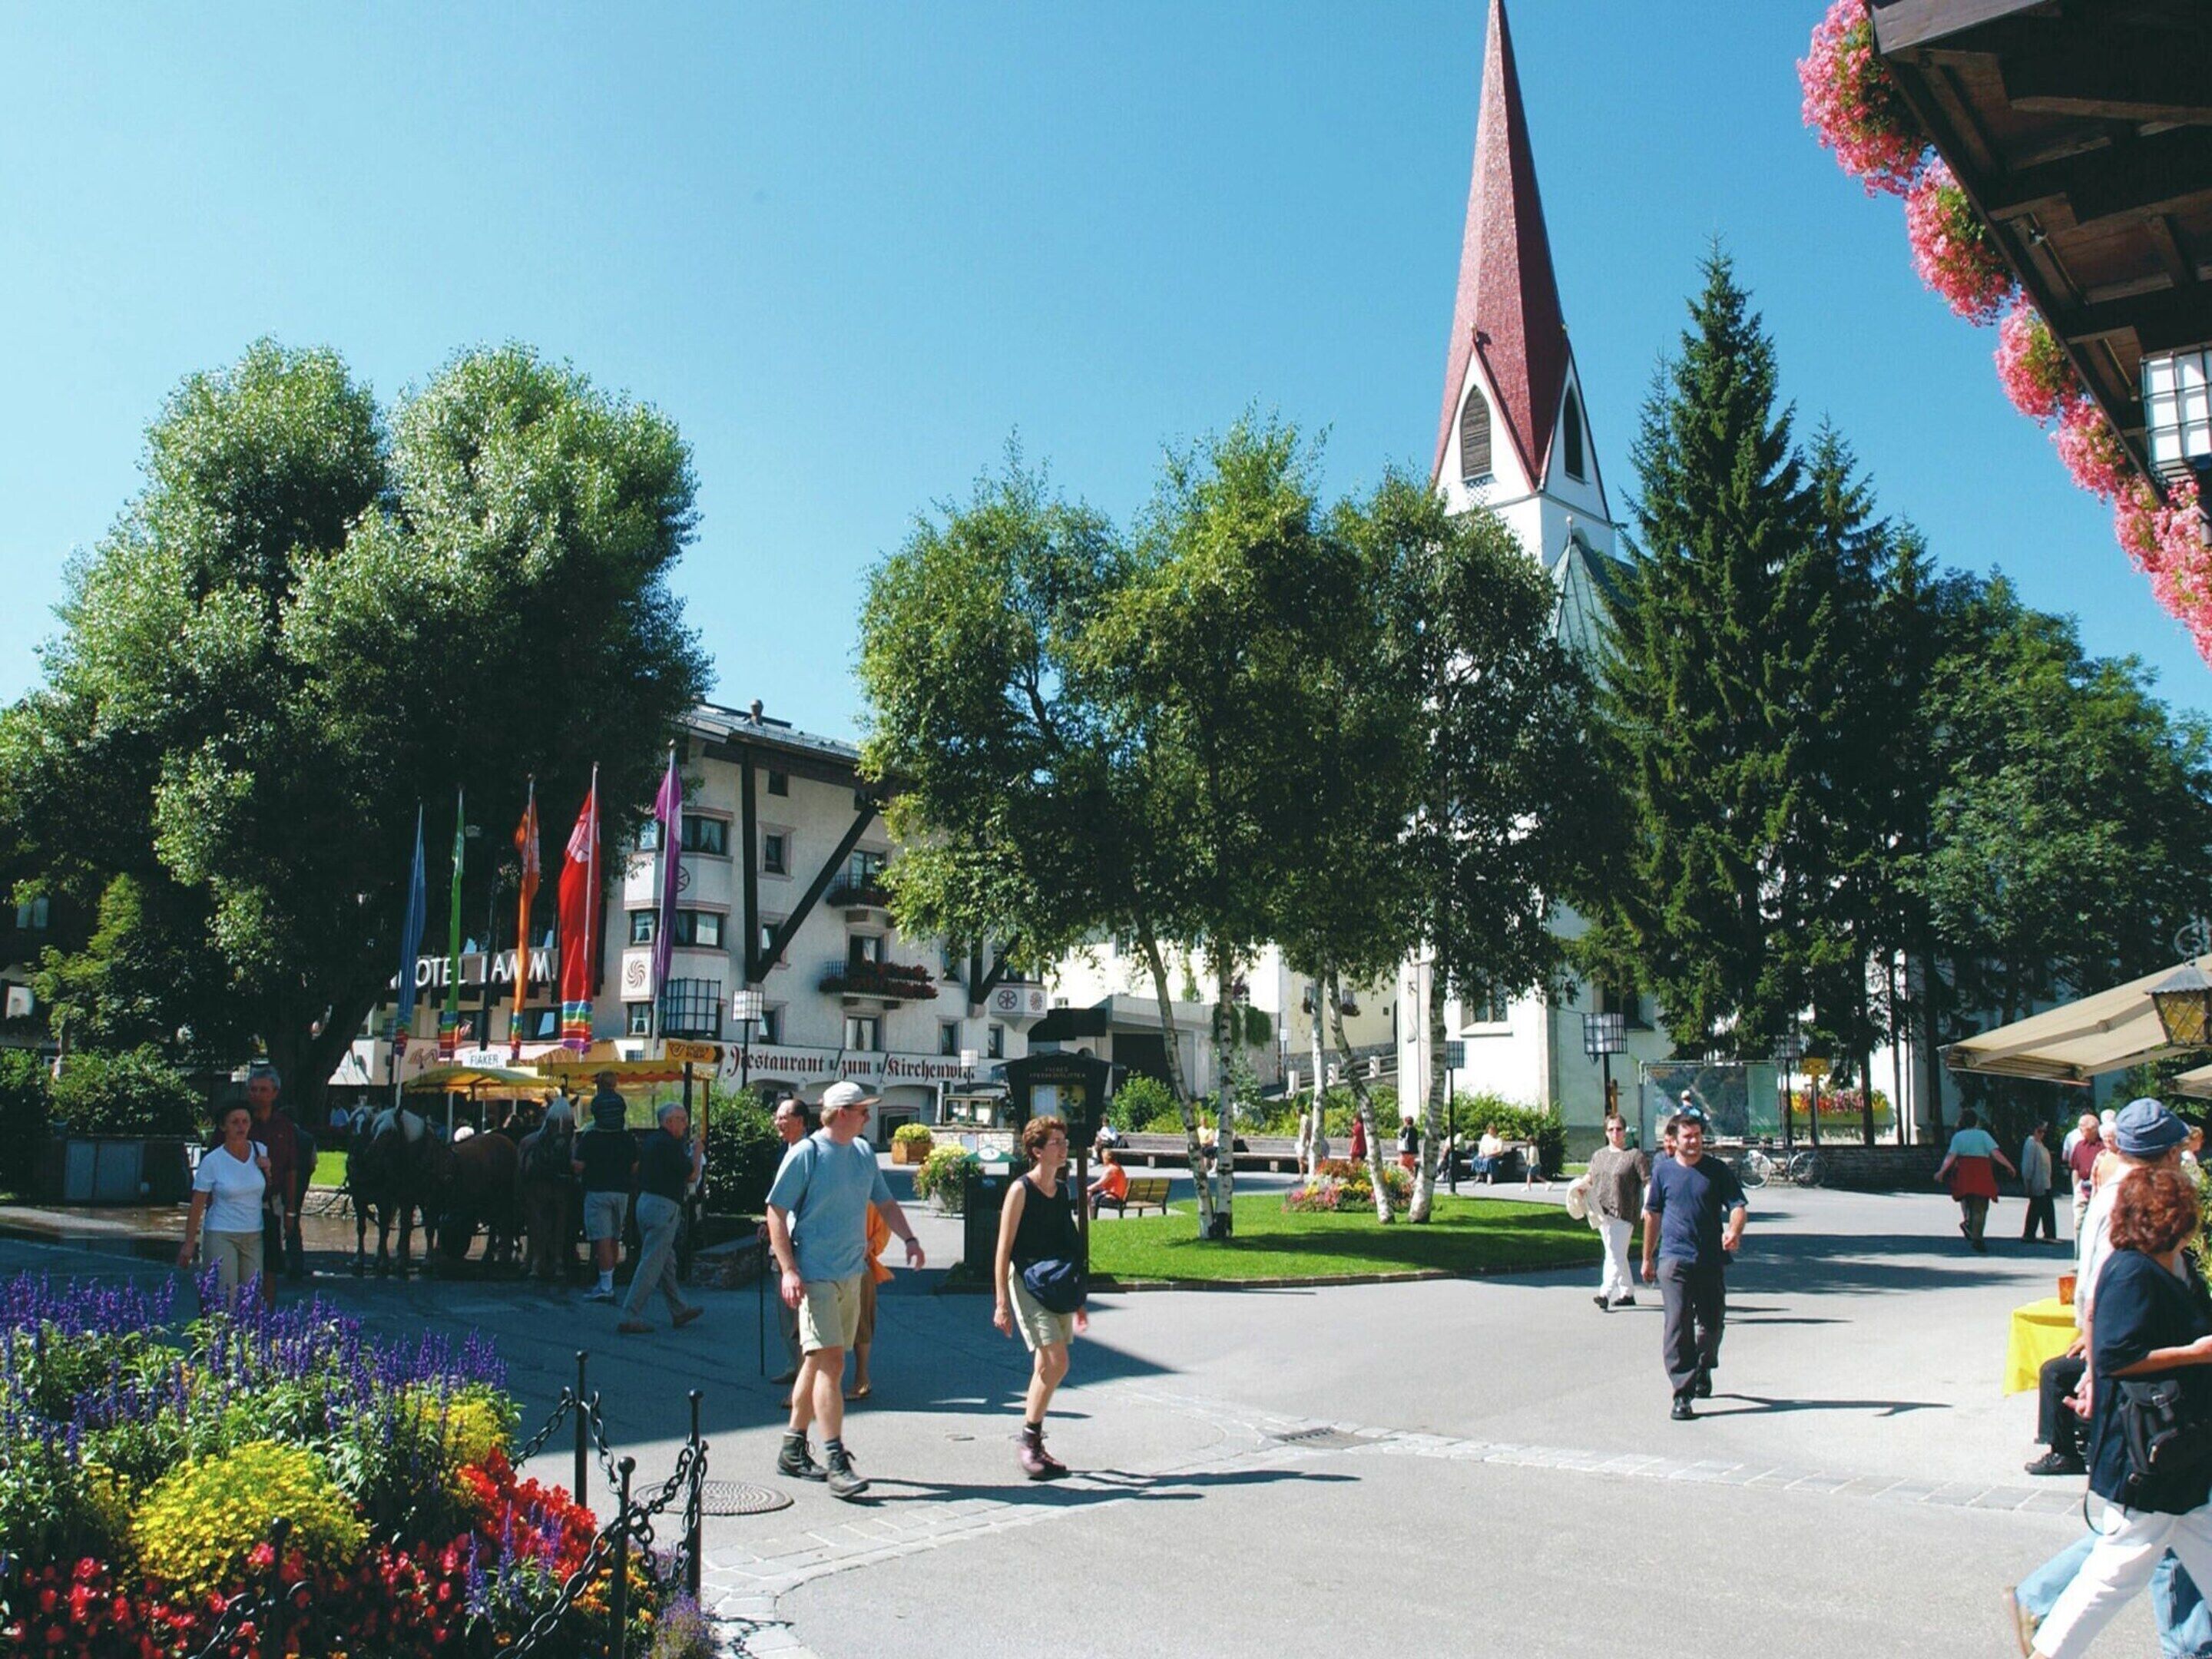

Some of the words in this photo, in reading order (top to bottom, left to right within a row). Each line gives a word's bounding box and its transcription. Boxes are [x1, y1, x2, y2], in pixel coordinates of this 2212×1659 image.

[390, 955, 468, 989] OTEL
[470, 1054, 499, 1065] FIAKER
[727, 1045, 825, 1077] Restaurant
[839, 1059, 871, 1080] zum
